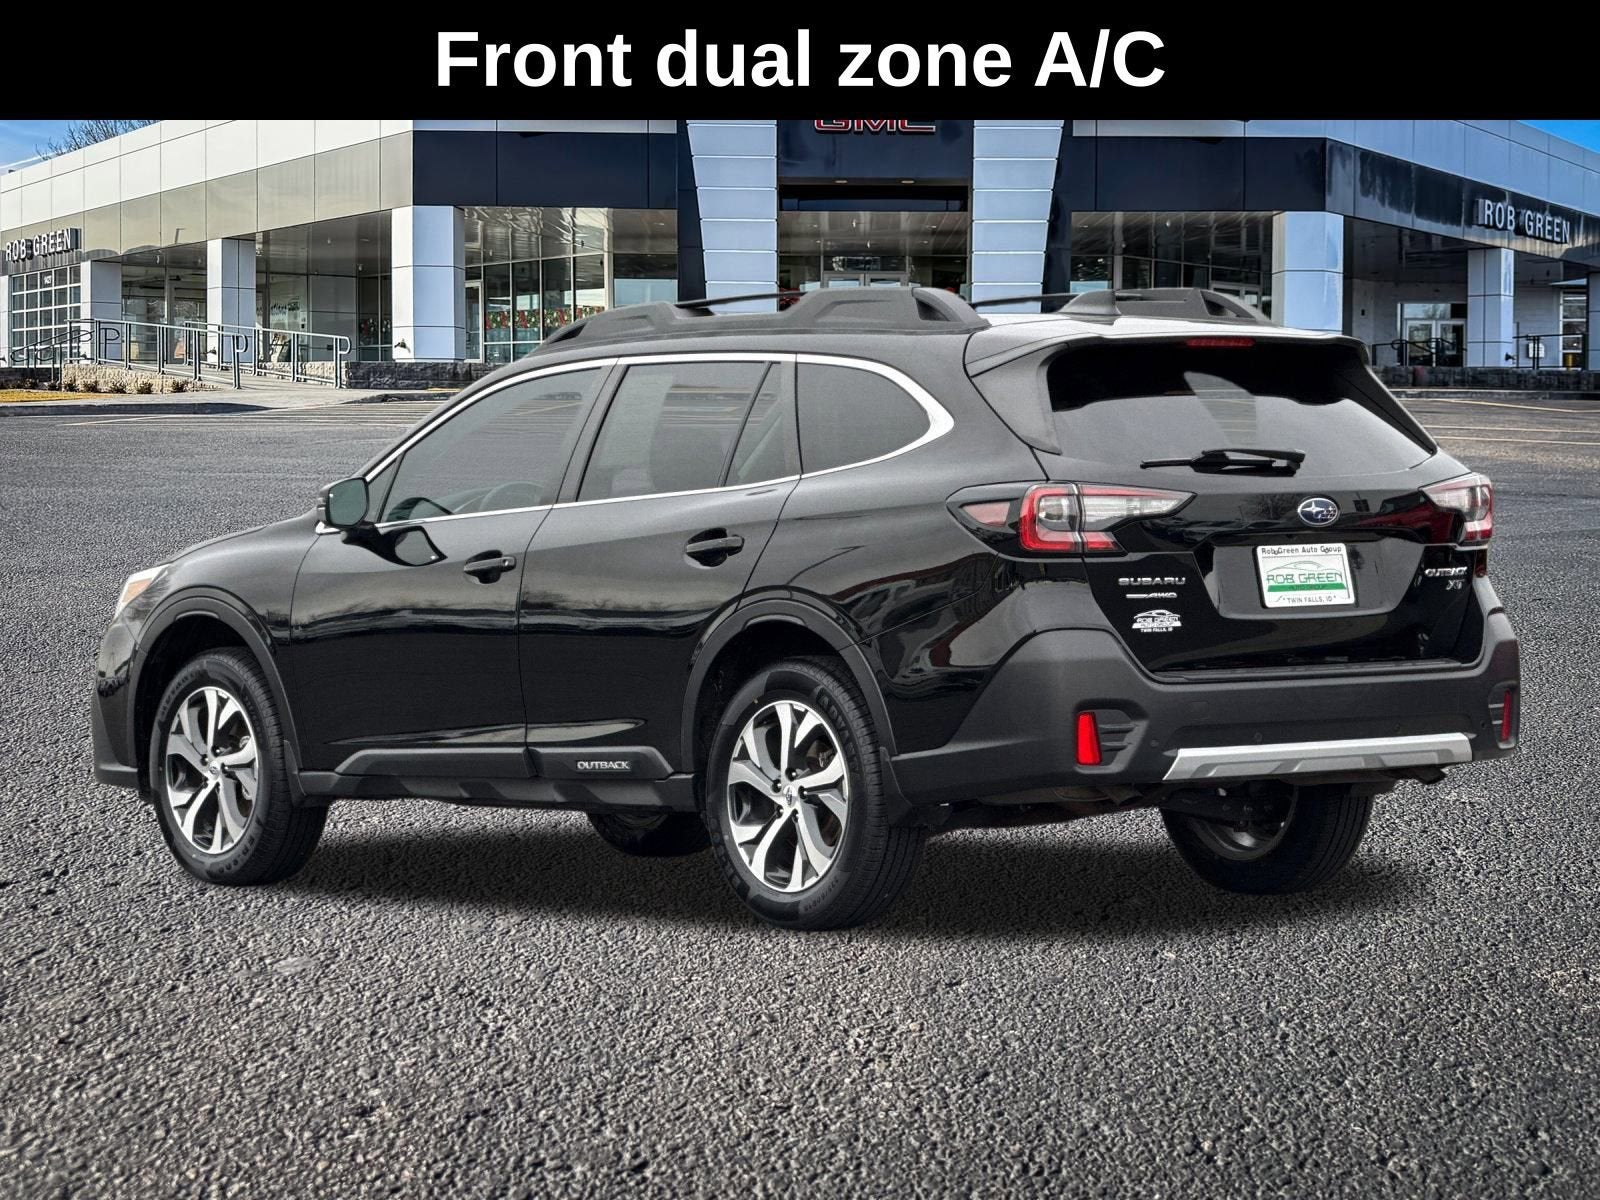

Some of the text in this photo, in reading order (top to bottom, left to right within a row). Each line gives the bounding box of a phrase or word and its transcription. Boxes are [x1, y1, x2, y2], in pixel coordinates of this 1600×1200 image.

[1484, 199, 1570, 243] ROB GREEN
[5, 227, 71, 262] ROB GREEN
[1118, 577, 1186, 586] SUBARU
[1266, 572, 1343, 584] ROB GREEN
[576, 761, 630, 770] OUTBACK
